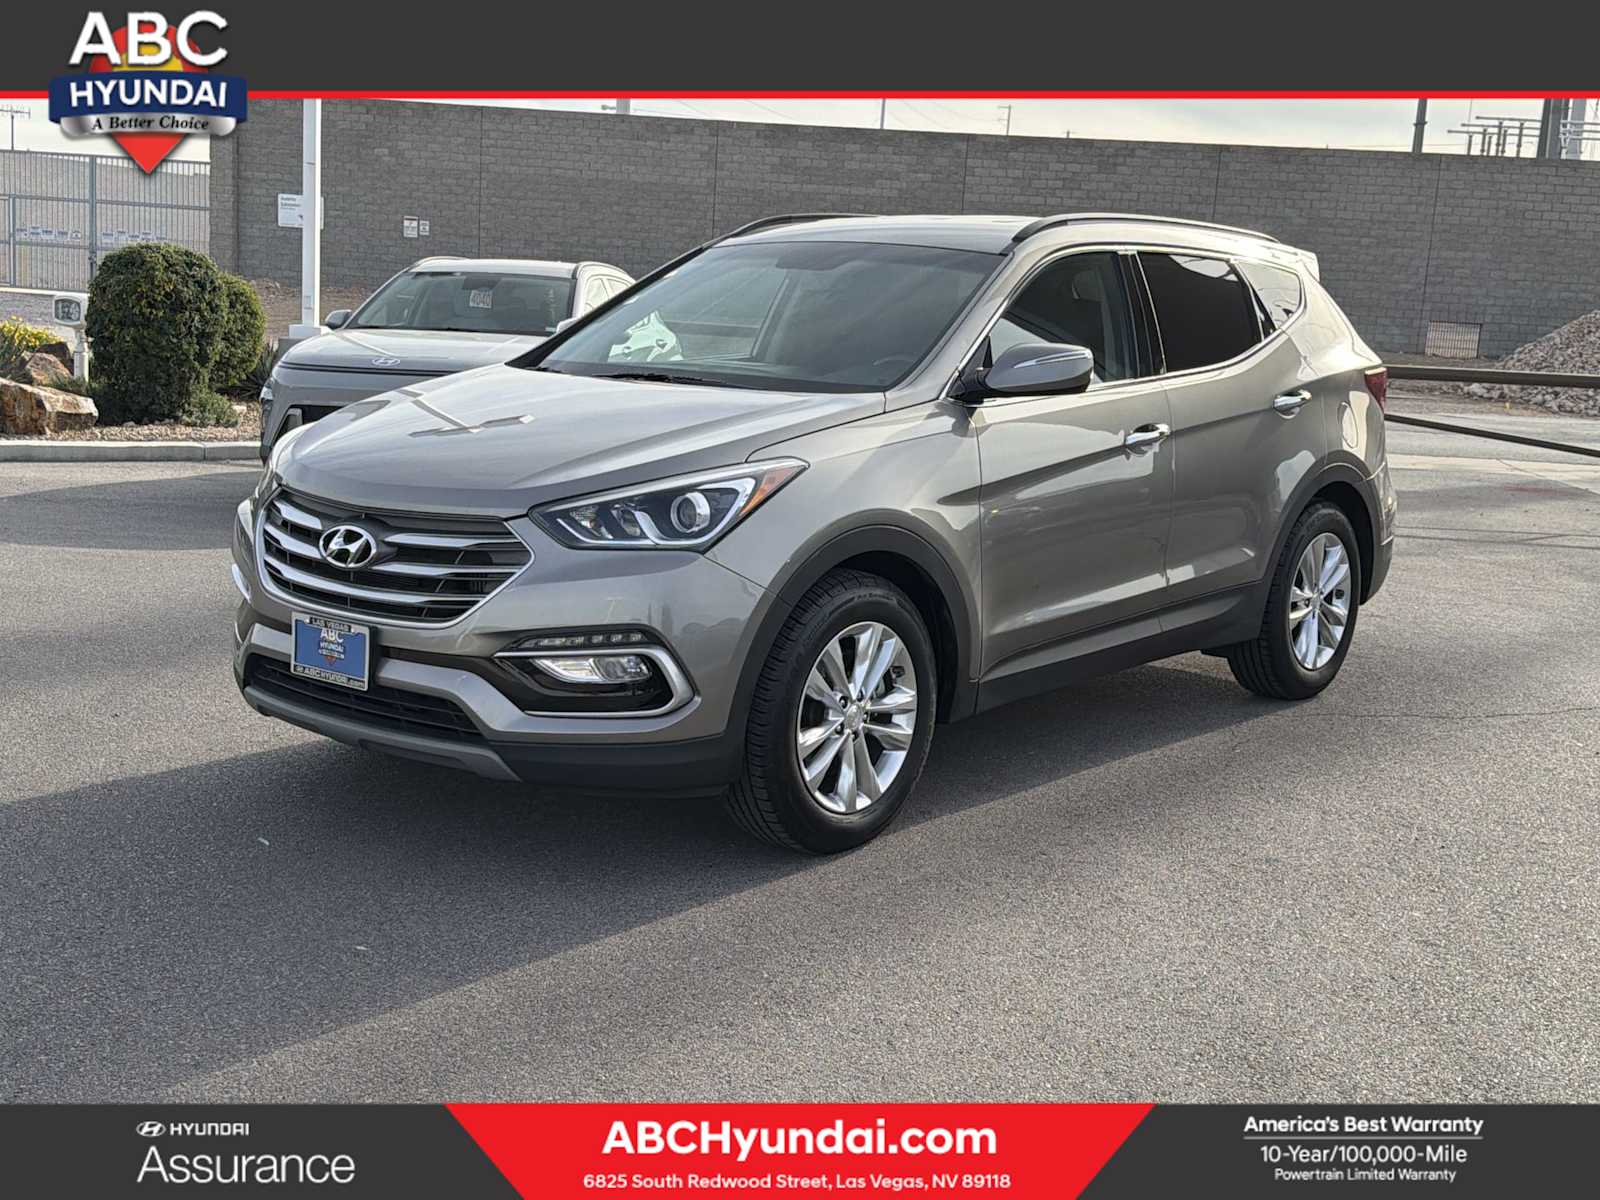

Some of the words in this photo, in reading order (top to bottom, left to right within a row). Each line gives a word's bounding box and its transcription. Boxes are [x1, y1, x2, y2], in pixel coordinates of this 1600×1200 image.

[311, 617, 326, 627] LAS
[327, 621, 350, 632] VEGAS
[320, 628, 344, 643] ABC
[319, 641, 344, 653] HYUNDAI
